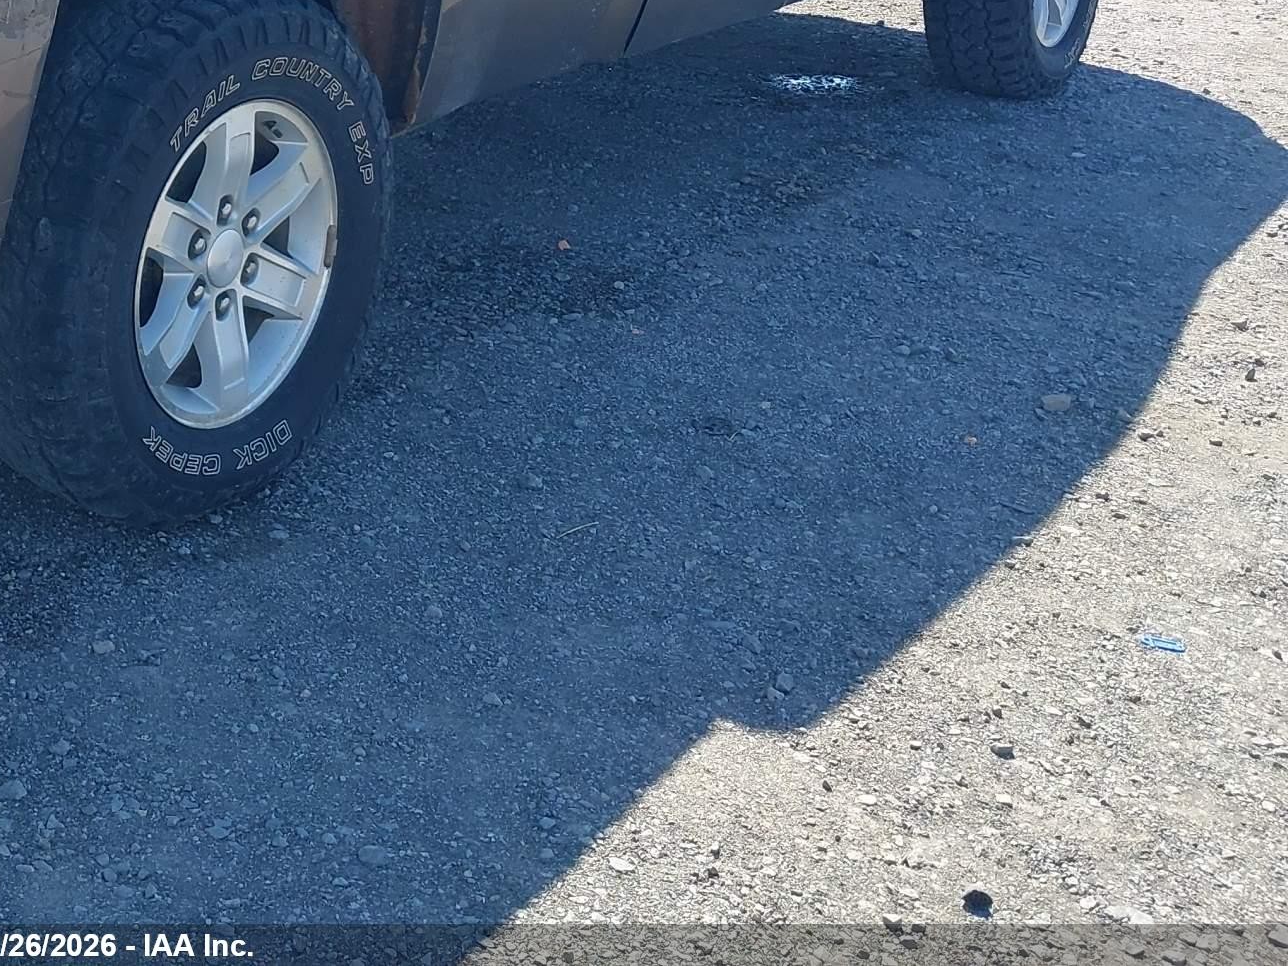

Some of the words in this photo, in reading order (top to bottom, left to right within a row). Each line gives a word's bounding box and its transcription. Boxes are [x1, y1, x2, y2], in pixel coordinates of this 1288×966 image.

[170, 75, 241, 152] TRAIL
[251, 57, 355, 111] COUNTRY
[347, 119, 375, 185] EXP
[142, 425, 222, 476] CEPEK
[233, 419, 292, 470] DICK
